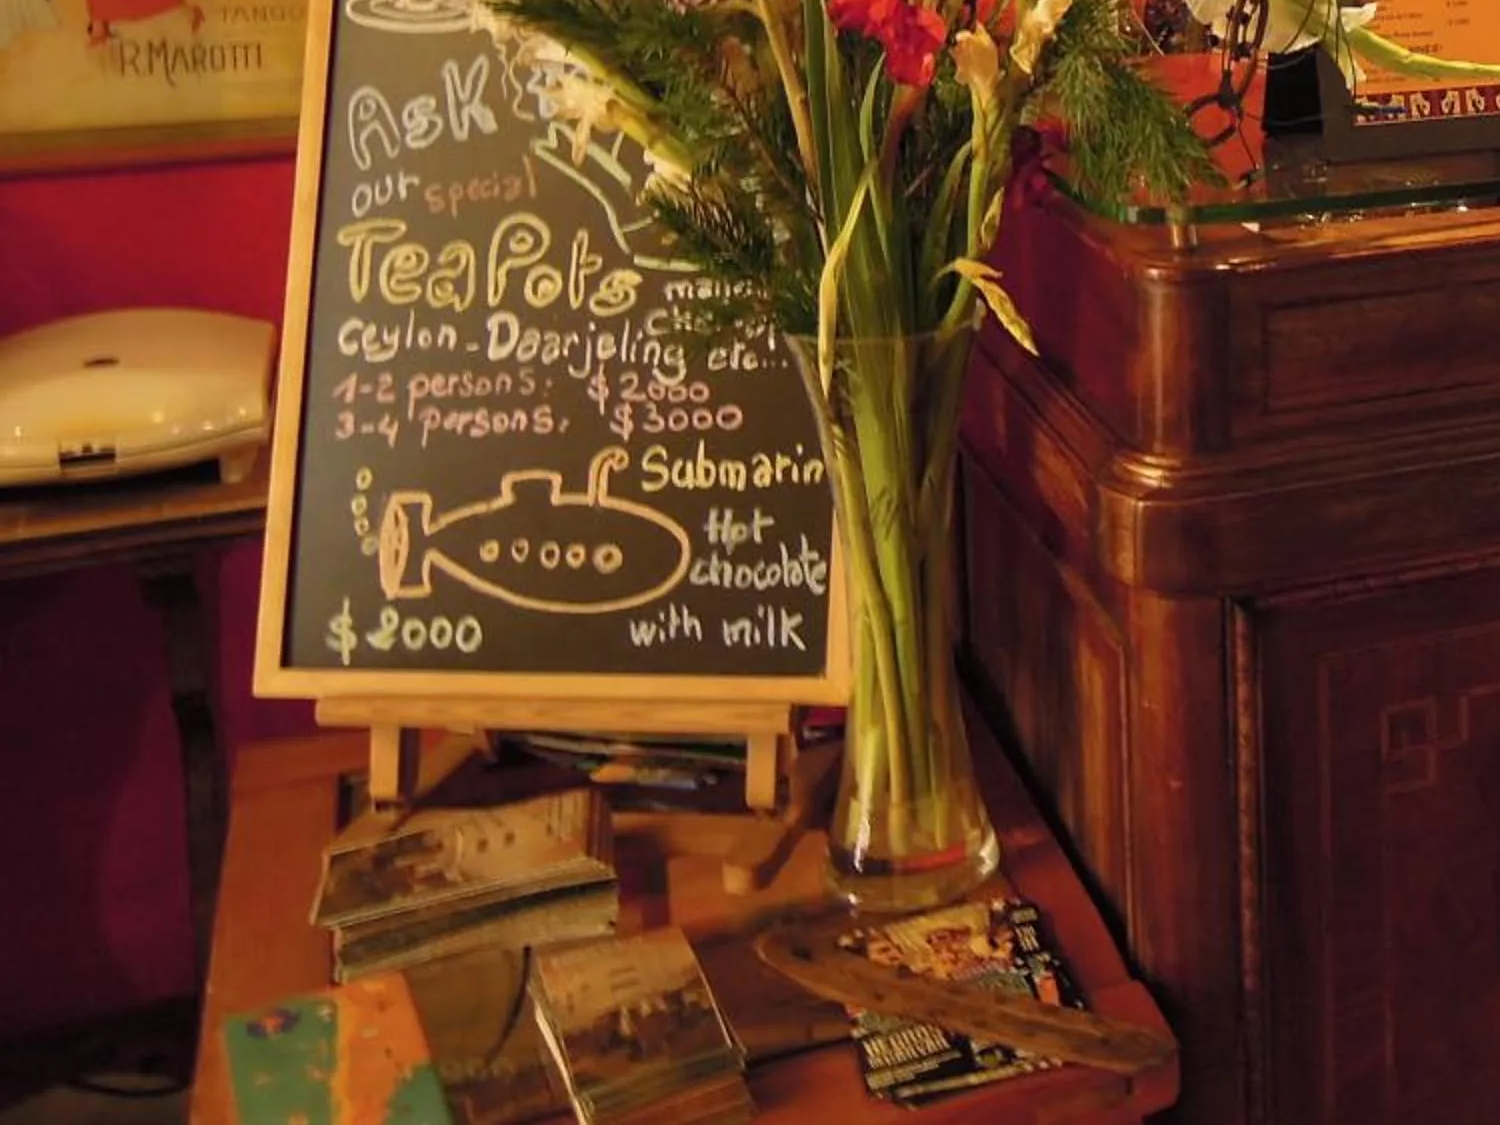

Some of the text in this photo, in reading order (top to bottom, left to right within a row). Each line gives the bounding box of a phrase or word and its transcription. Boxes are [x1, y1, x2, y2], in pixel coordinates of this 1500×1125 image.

[351, 153, 537, 219] our special
[703, 506, 775, 555] Hot
[689, 531, 828, 596] chocolate
[630, 601, 703, 647] with
